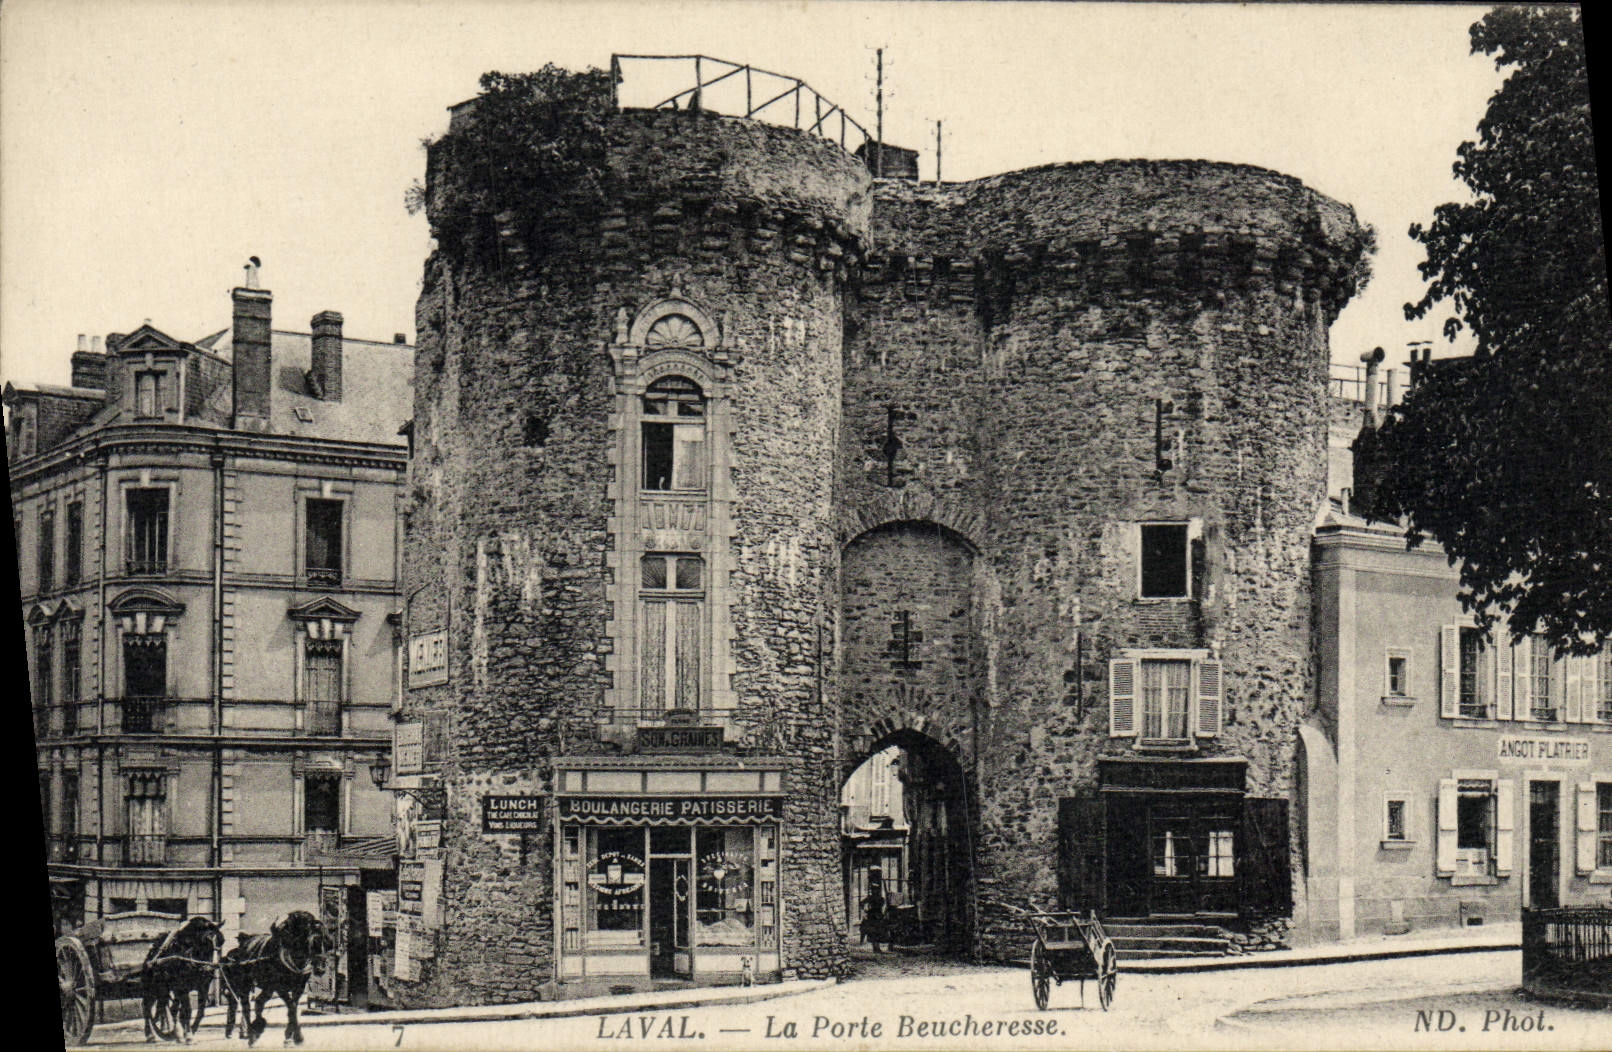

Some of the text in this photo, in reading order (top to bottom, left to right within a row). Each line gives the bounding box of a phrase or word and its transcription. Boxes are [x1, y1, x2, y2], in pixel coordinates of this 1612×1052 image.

[1500, 740, 1588, 759] ANGOT PLATRIER
[490, 798, 537, 810] LUNCH
[570, 800, 774, 815] BOULANGERIE PATISSERIE
